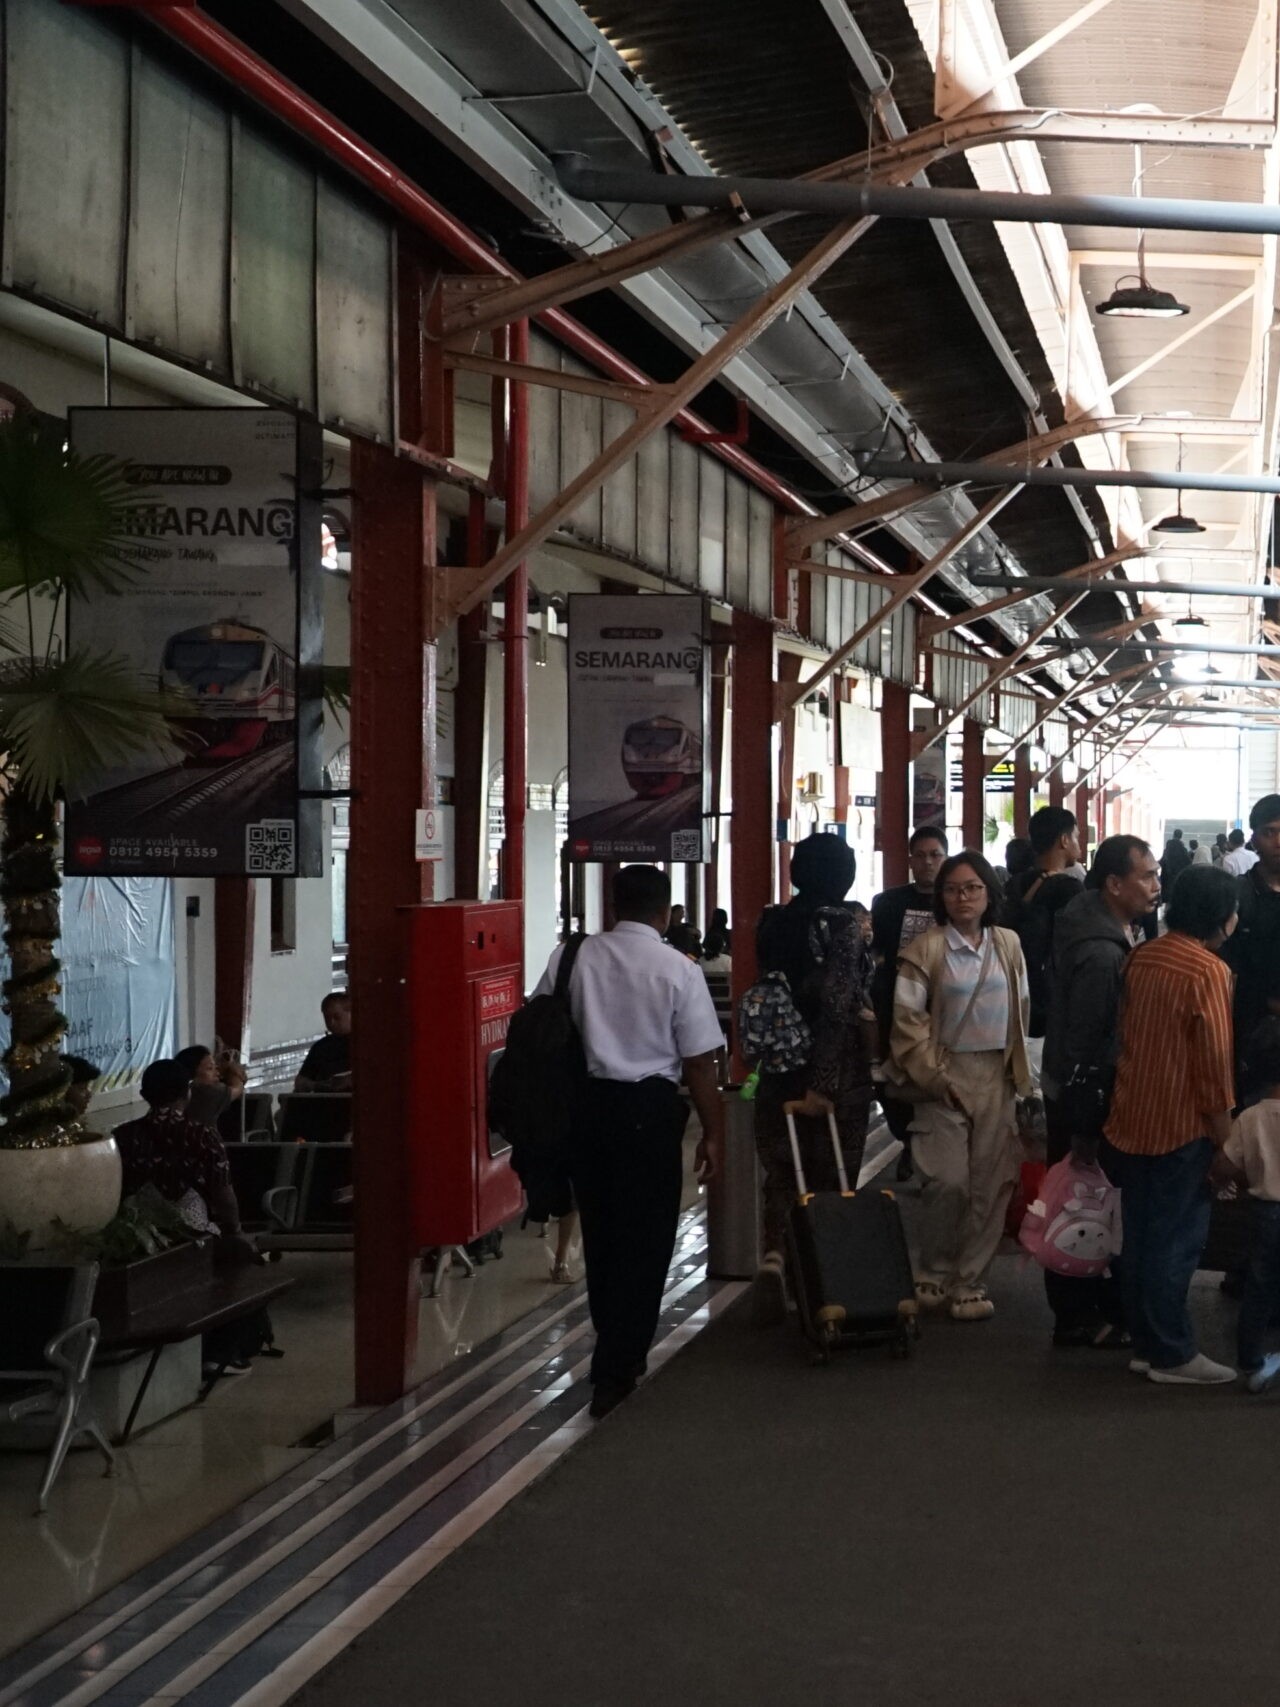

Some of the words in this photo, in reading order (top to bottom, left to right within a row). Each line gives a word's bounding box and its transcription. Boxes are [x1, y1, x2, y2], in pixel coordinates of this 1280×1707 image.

[107, 507, 292, 536] EMARANG
[575, 651, 697, 669] SEMARANG
[109, 837, 141, 846] SPACE
[109, 846, 140, 857] 0812
[145, 847, 179, 857] 4954
[184, 847, 218, 858] 5359
[481, 1013, 512, 1046] HYDRA
